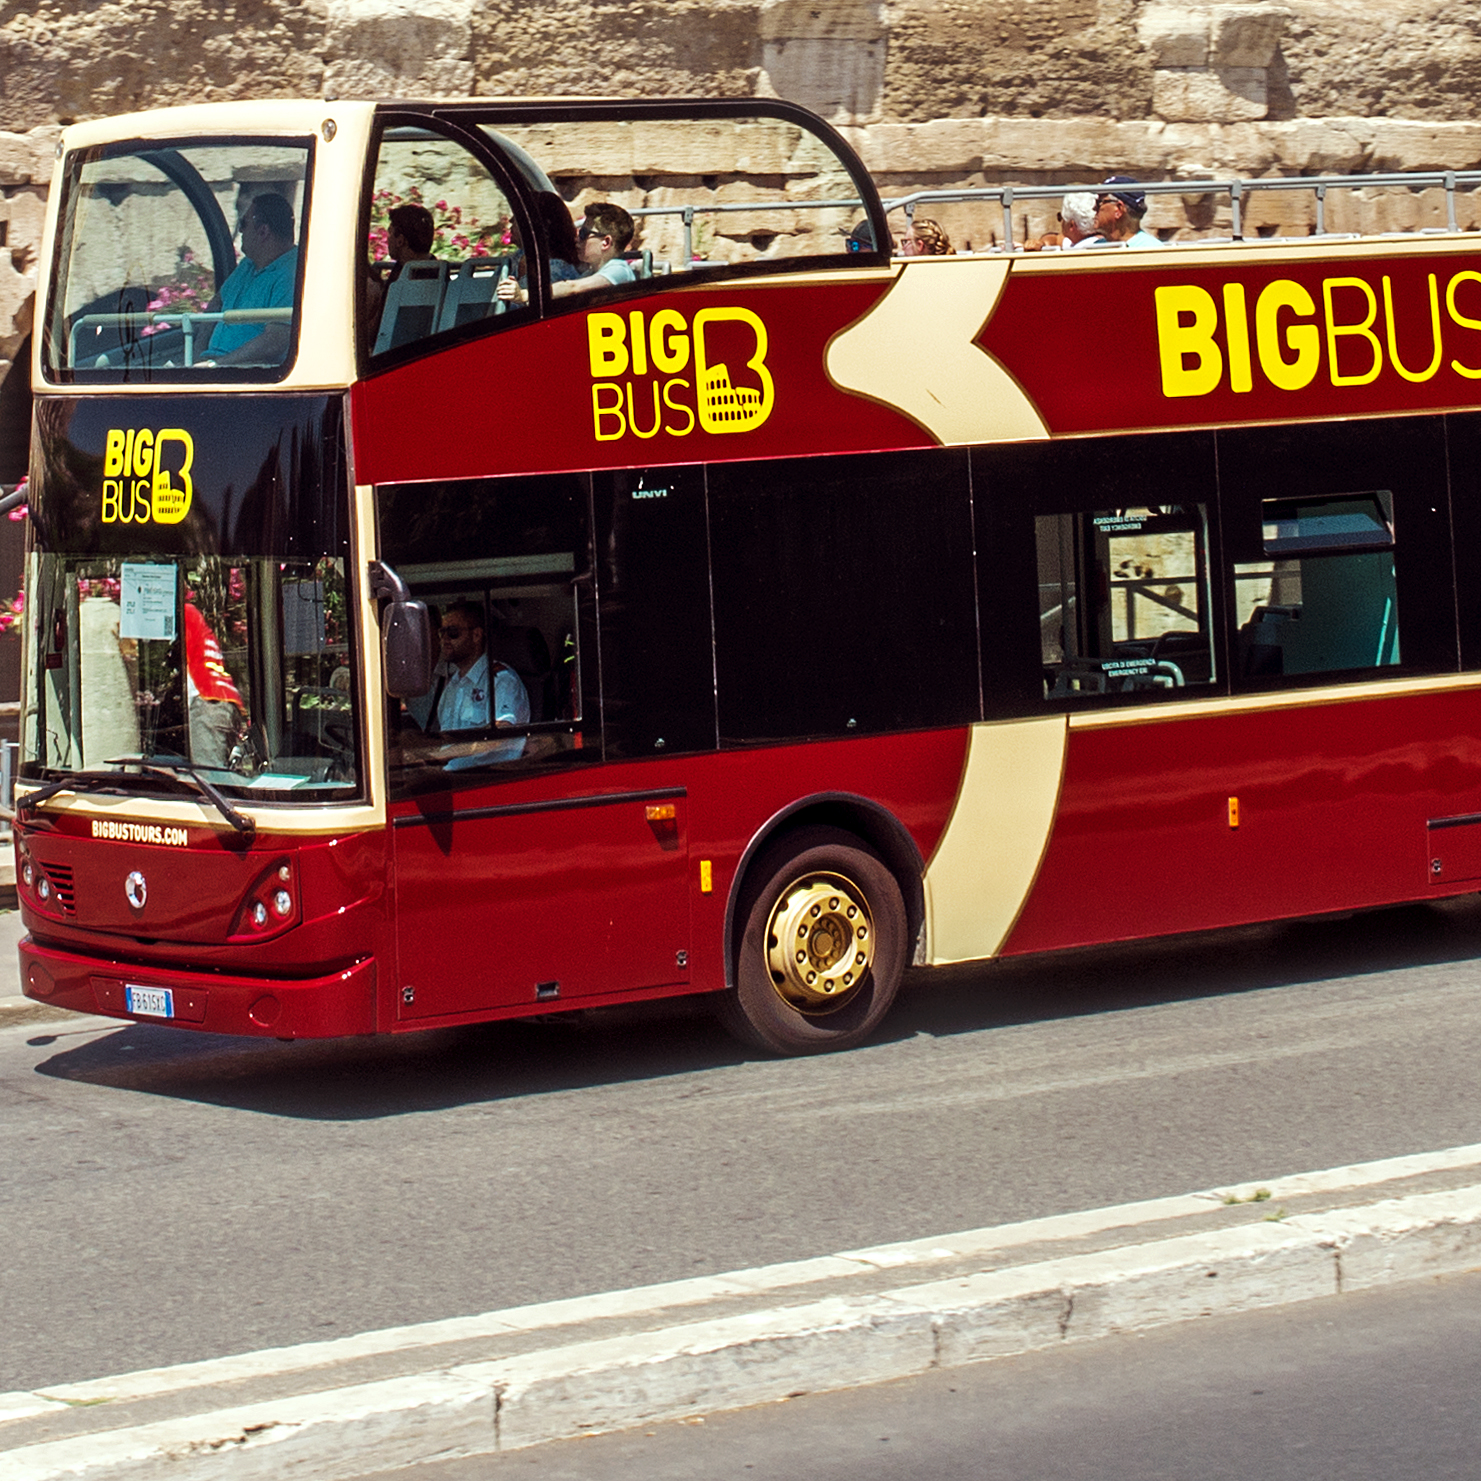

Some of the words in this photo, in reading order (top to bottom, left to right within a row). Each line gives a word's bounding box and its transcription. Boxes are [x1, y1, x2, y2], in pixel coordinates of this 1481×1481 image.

[586, 308, 690, 378] BIG
[591, 378, 695, 442] BUS
[103, 428, 154, 478] BIG
[101, 479, 151, 524] BUS
[91, 819, 189, 847] BIGBUSTOURS.COM
